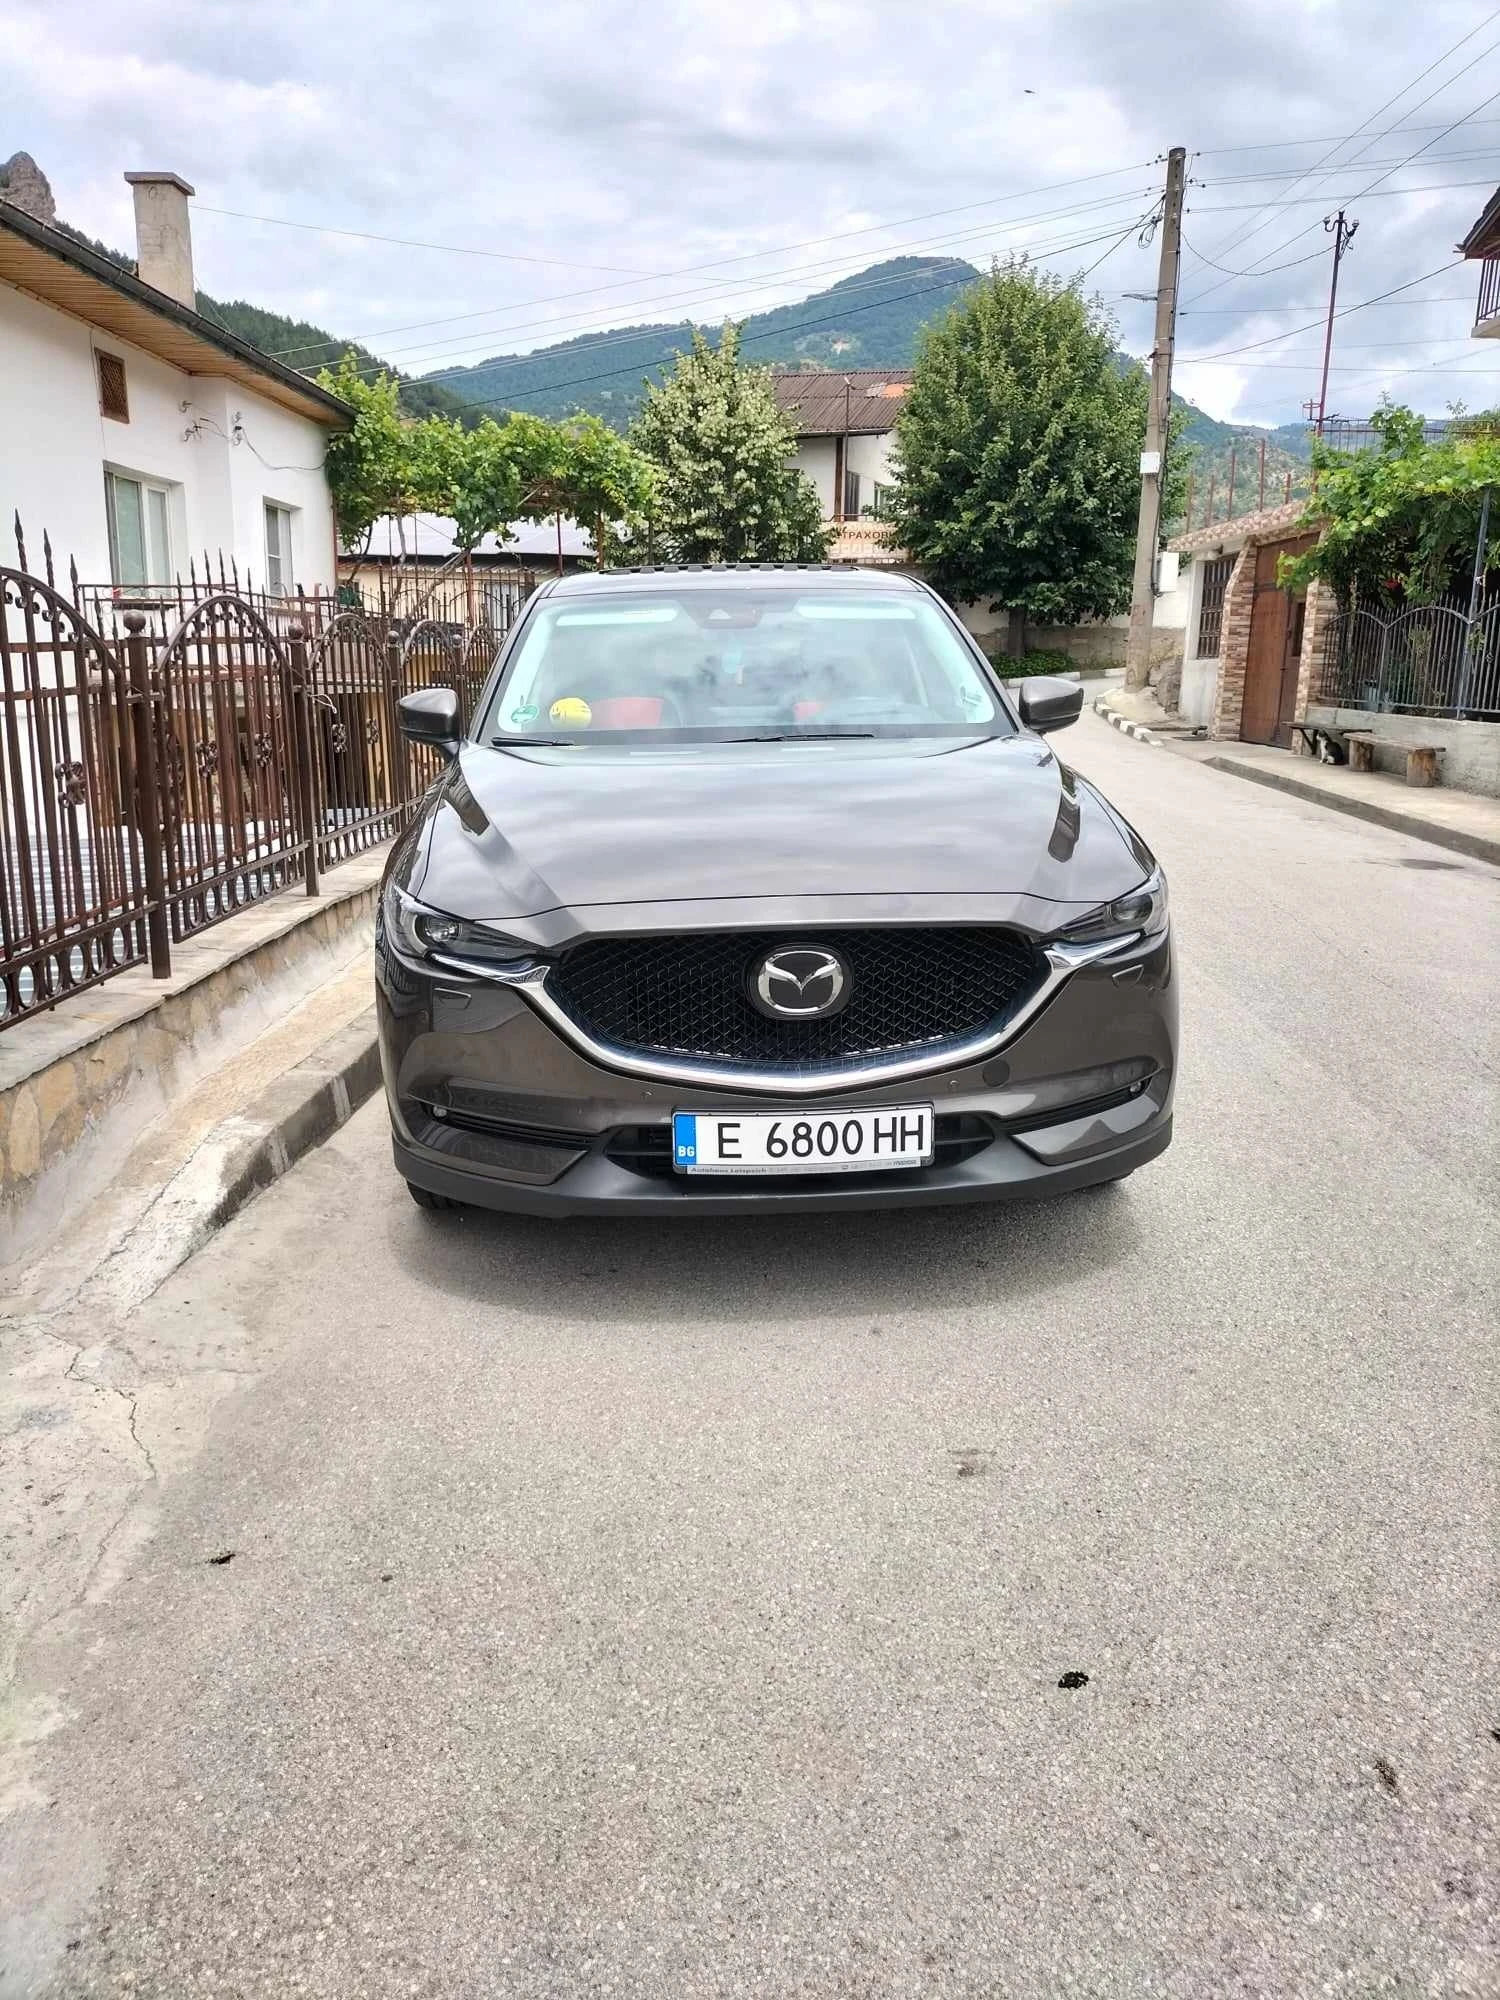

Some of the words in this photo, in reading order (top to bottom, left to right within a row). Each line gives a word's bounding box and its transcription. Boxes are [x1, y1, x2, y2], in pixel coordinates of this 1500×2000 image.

[717, 1122, 742, 1159] E
[766, 1119, 864, 1159] 6800
[873, 1114, 924, 1154] HH
[678, 1145, 695, 1157] BG
